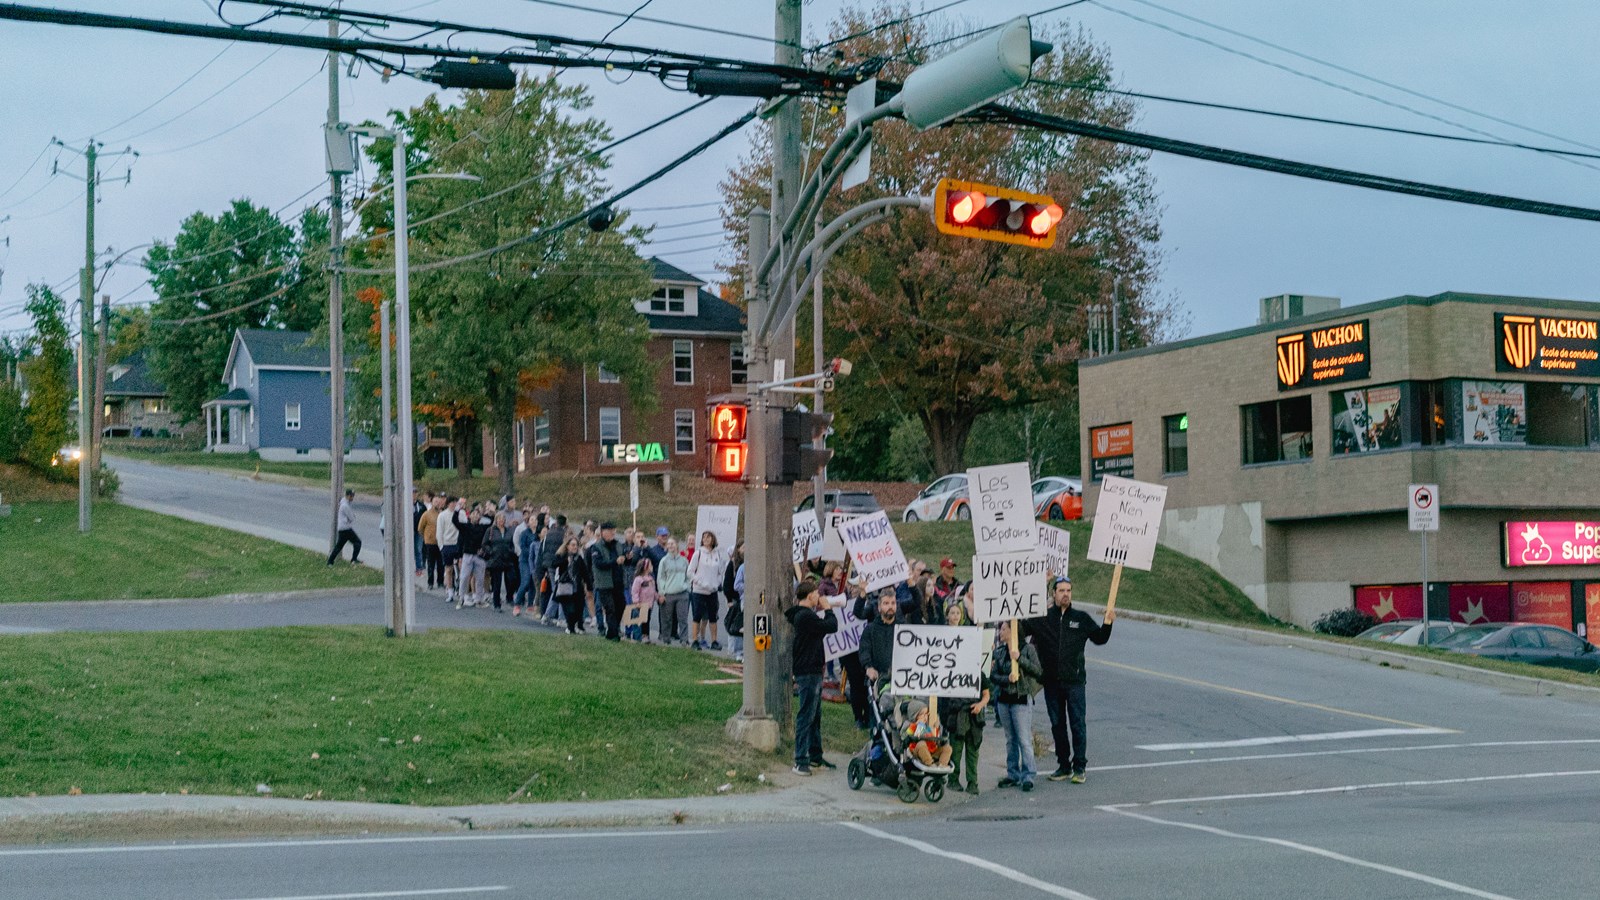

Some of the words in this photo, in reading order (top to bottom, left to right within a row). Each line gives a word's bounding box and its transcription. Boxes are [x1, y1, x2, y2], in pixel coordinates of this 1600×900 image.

[1311, 323, 1363, 349] VACHON
[1540, 318, 1598, 339] VACHON
[1312, 357, 1329, 370] École
[1329, 355, 1337, 366] de
[1338, 351, 1364, 365] conduite
[1541, 346, 1559, 358] École
[1560, 348, 1569, 358] de
[1569, 349, 1598, 360] conduite
[1312, 367, 1344, 380] supérieure
[1541, 358, 1576, 370] supérieure
[978, 473, 1009, 493] Les
[1103, 478, 1125, 495] Les
[1128, 486, 1161, 503] Citoyens
[982, 494, 1014, 511] Parcs
[1111, 533, 1129, 550] Plus
[876, 561, 906, 579] courir
[1001, 579, 1019, 595] DE
[984, 593, 1039, 618] TAXE
[897, 630, 922, 647] On
[926, 635, 964, 649] veut
[916, 648, 956, 669] des
[894, 668, 938, 690] Jeux
